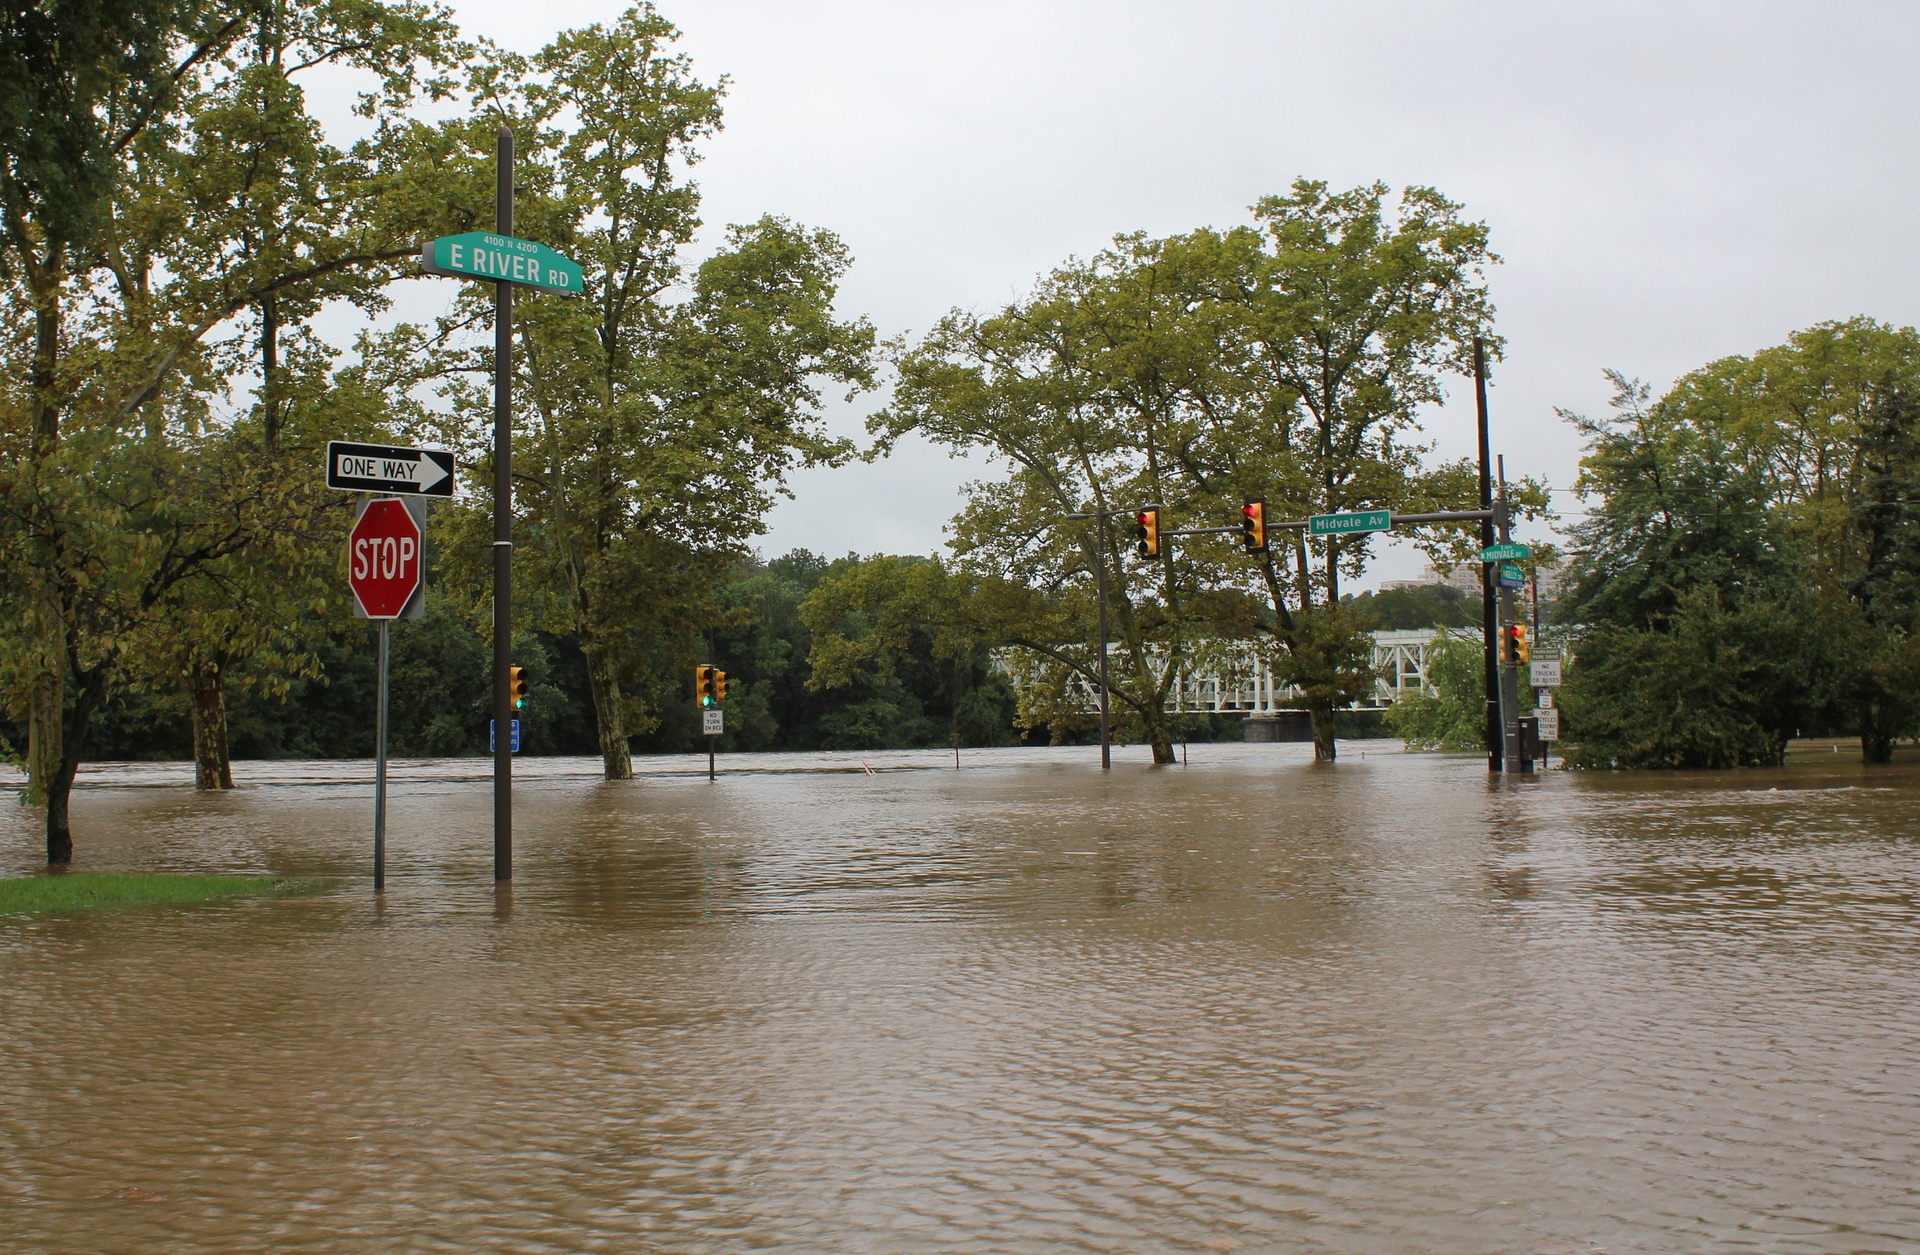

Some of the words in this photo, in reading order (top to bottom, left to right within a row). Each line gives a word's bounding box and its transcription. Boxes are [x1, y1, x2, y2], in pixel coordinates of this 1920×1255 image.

[484, 236, 504, 247] 4100
[508, 240, 513, 248] N
[517, 242, 538, 254] 4200
[451, 244, 464, 268] E
[474, 248, 540, 282] RIVER
[549, 269, 569, 287] RD
[342, 458, 376, 476] ONE
[383, 461, 417, 480] WAY
[1316, 518, 1361, 530] Midvale
[1368, 516, 1384, 526] Av
[354, 536, 414, 580] STOP
[1486, 550, 1514, 559] MIDVALE
